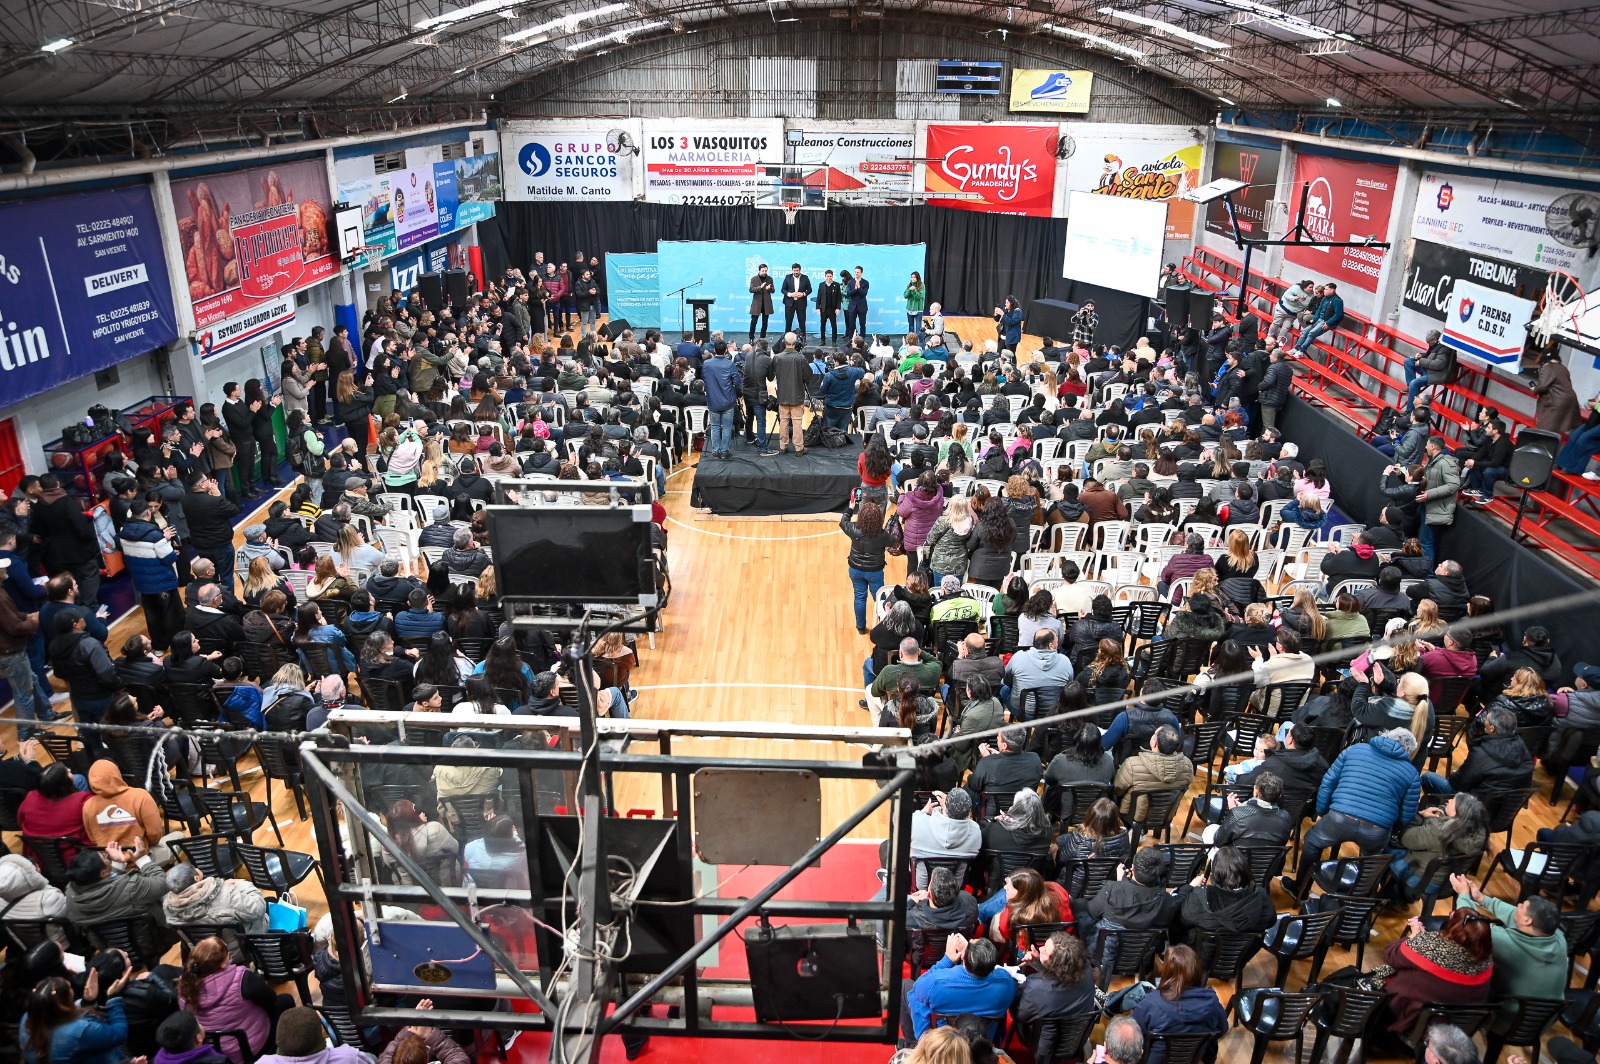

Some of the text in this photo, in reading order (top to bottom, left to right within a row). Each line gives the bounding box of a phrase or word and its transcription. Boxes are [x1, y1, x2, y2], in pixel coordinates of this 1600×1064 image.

[554, 142, 617, 153] GRUPO
[651, 136, 768, 151] LOS 3 VASQUITOS
[836, 137, 913, 148] Construcciones
[554, 155, 617, 165] SANCOR
[668, 151, 752, 162] MARMOLERIA
[555, 167, 617, 177] SEGUROS
[527, 185, 612, 195] Matilde M. Canto
[1477, 195, 1498, 205] PLACAS
[1500, 198, 1524, 209] MASILLA
[76, 223, 92, 234] TEL:
[91, 219, 112, 232] 02225
[1307, 215, 1335, 238] PIARA
[1481, 216, 1504, 227] PERFILES
[77, 236, 89, 249] AV.
[88, 230, 125, 246] SARMIENTO
[94, 244, 128, 258] SAN VICENTE
[91, 268, 139, 291] DELIVERY
[1468, 257, 1518, 288] TRIBUNA
[1405, 266, 1436, 307] Juan
[96, 313, 111, 324] TEL:
[110, 307, 130, 320] 02225
[218, 303, 288, 340] ESTADIO SALVADOR LEONE
[1480, 304, 1512, 325] PRENSA
[92, 322, 121, 340] HIPOLITO
[120, 313, 151, 330] YRIGOYEN
[1477, 318, 1506, 338] C.D.S.V.
[113, 327, 145, 345] SAN VICENTE
